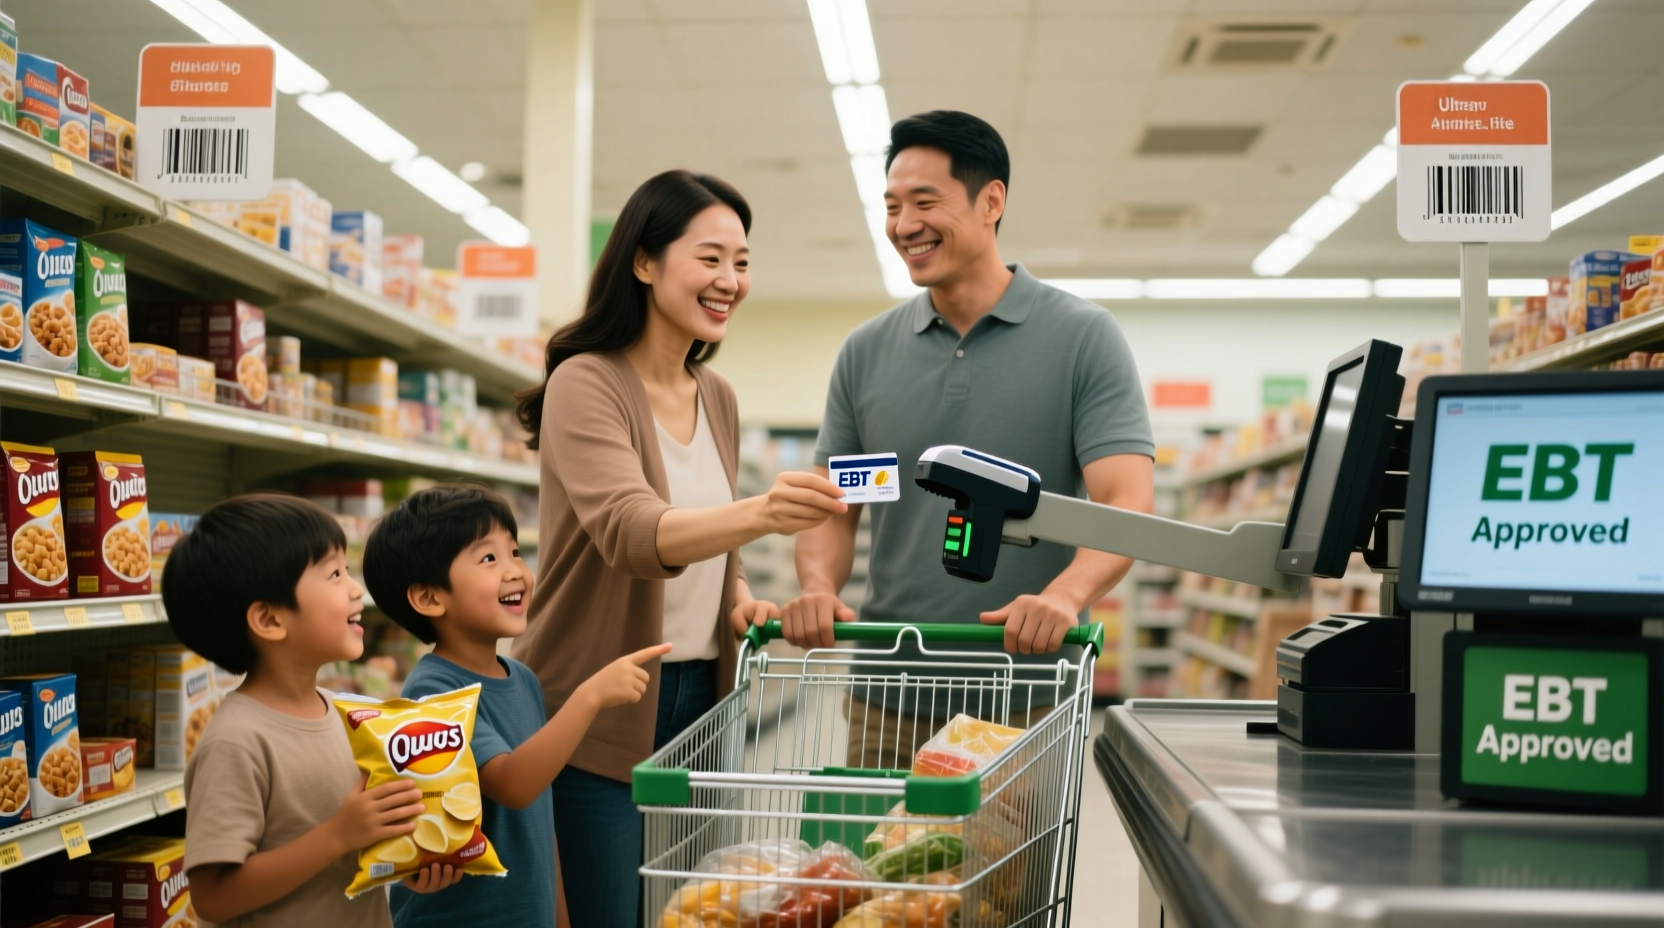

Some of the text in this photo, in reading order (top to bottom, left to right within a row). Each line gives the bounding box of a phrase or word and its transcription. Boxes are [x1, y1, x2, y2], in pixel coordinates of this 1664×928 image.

[838, 470, 871, 487] EBT
[1480, 442, 1635, 503] EBT
[1470, 516, 1630, 550] Approved
[1502, 673, 1608, 725] EBT
[1475, 724, 1634, 764] Approved
